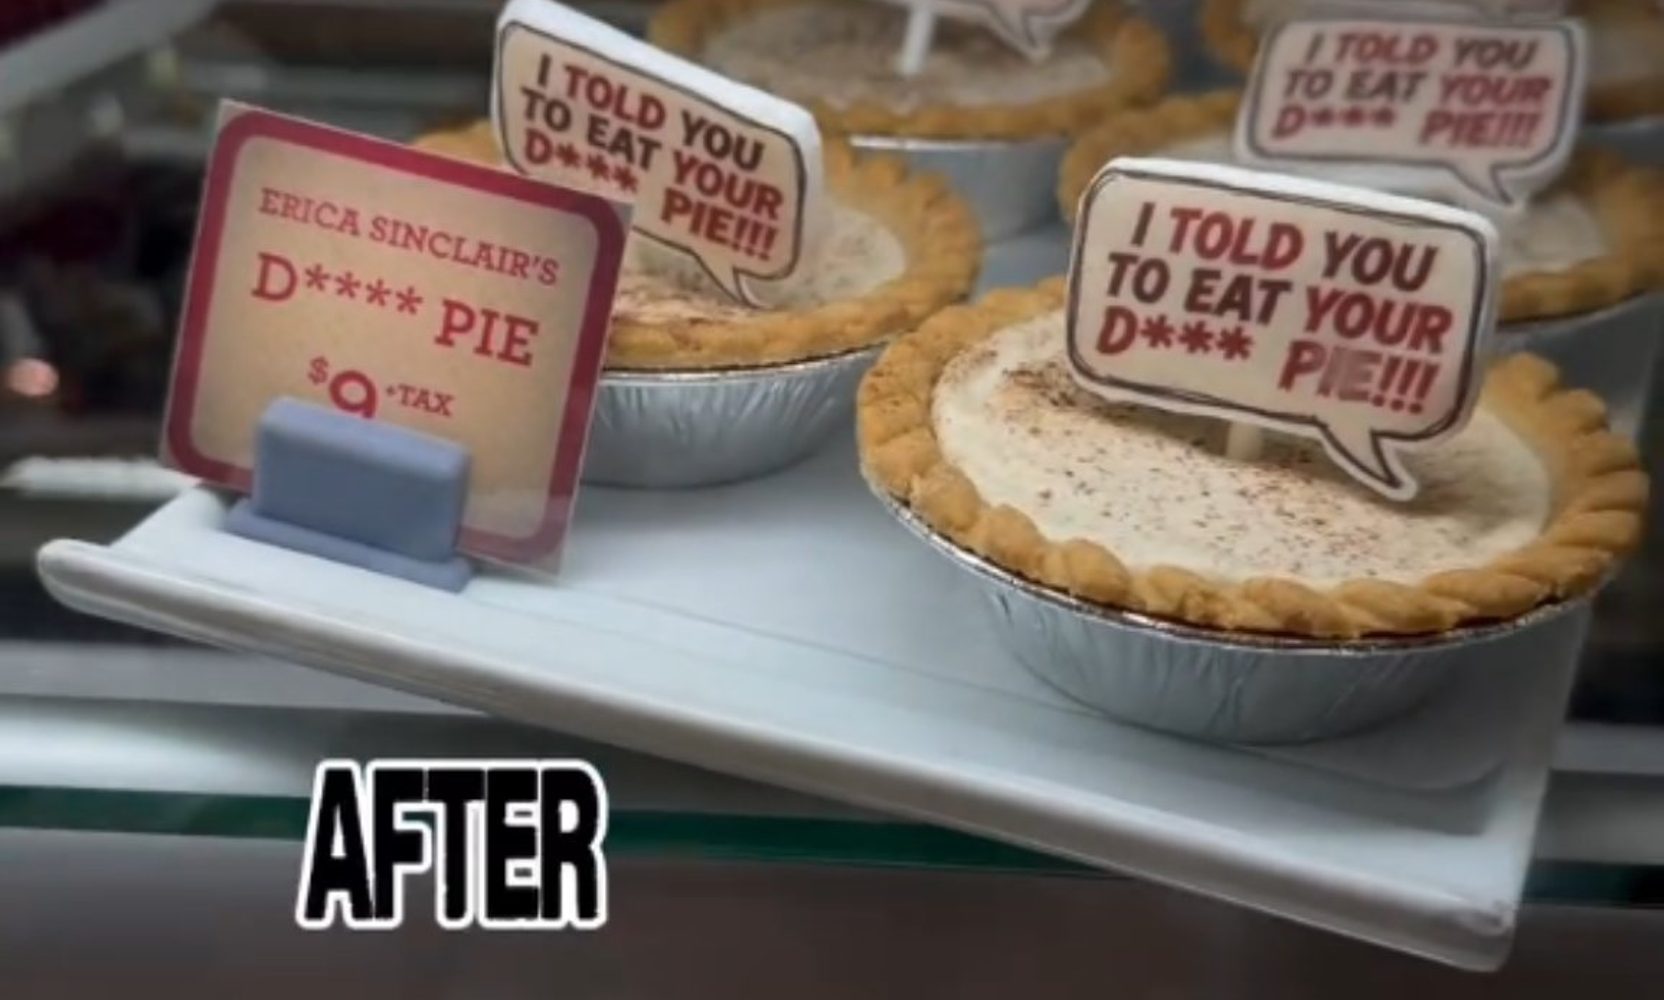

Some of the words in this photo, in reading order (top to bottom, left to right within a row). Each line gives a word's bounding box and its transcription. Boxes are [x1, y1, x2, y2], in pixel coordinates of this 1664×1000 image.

[1283, 69, 1333, 98] TO
[1343, 70, 1427, 102] EAT
[1439, 75, 1554, 104] YOUR
[1304, 33, 1324, 62] I
[1335, 32, 1438, 64] TOLD
[1453, 37, 1539, 69] YOU
[521, 87, 572, 132] TO
[587, 112, 661, 171] EAT
[673, 150, 784, 221] YOUR
[536, 53, 552, 87] I
[564, 64, 666, 131] TOLD
[681, 109, 764, 172] YOU
[259, 187, 361, 236] ERICA
[368, 214, 559, 286] SINCLAIR'S
[660, 186, 778, 262] PIE!!!
[1130, 202, 1155, 247] I
[1168, 207, 1304, 271] TOLD
[1322, 230, 1439, 292] YOU
[434, 299, 539, 366] PIE
[1106, 252, 1171, 304] TO
[1184, 269, 1292, 325] EAT
[1303, 285, 1452, 354] YOUR
[1277, 340, 1441, 415] PIE!!!
